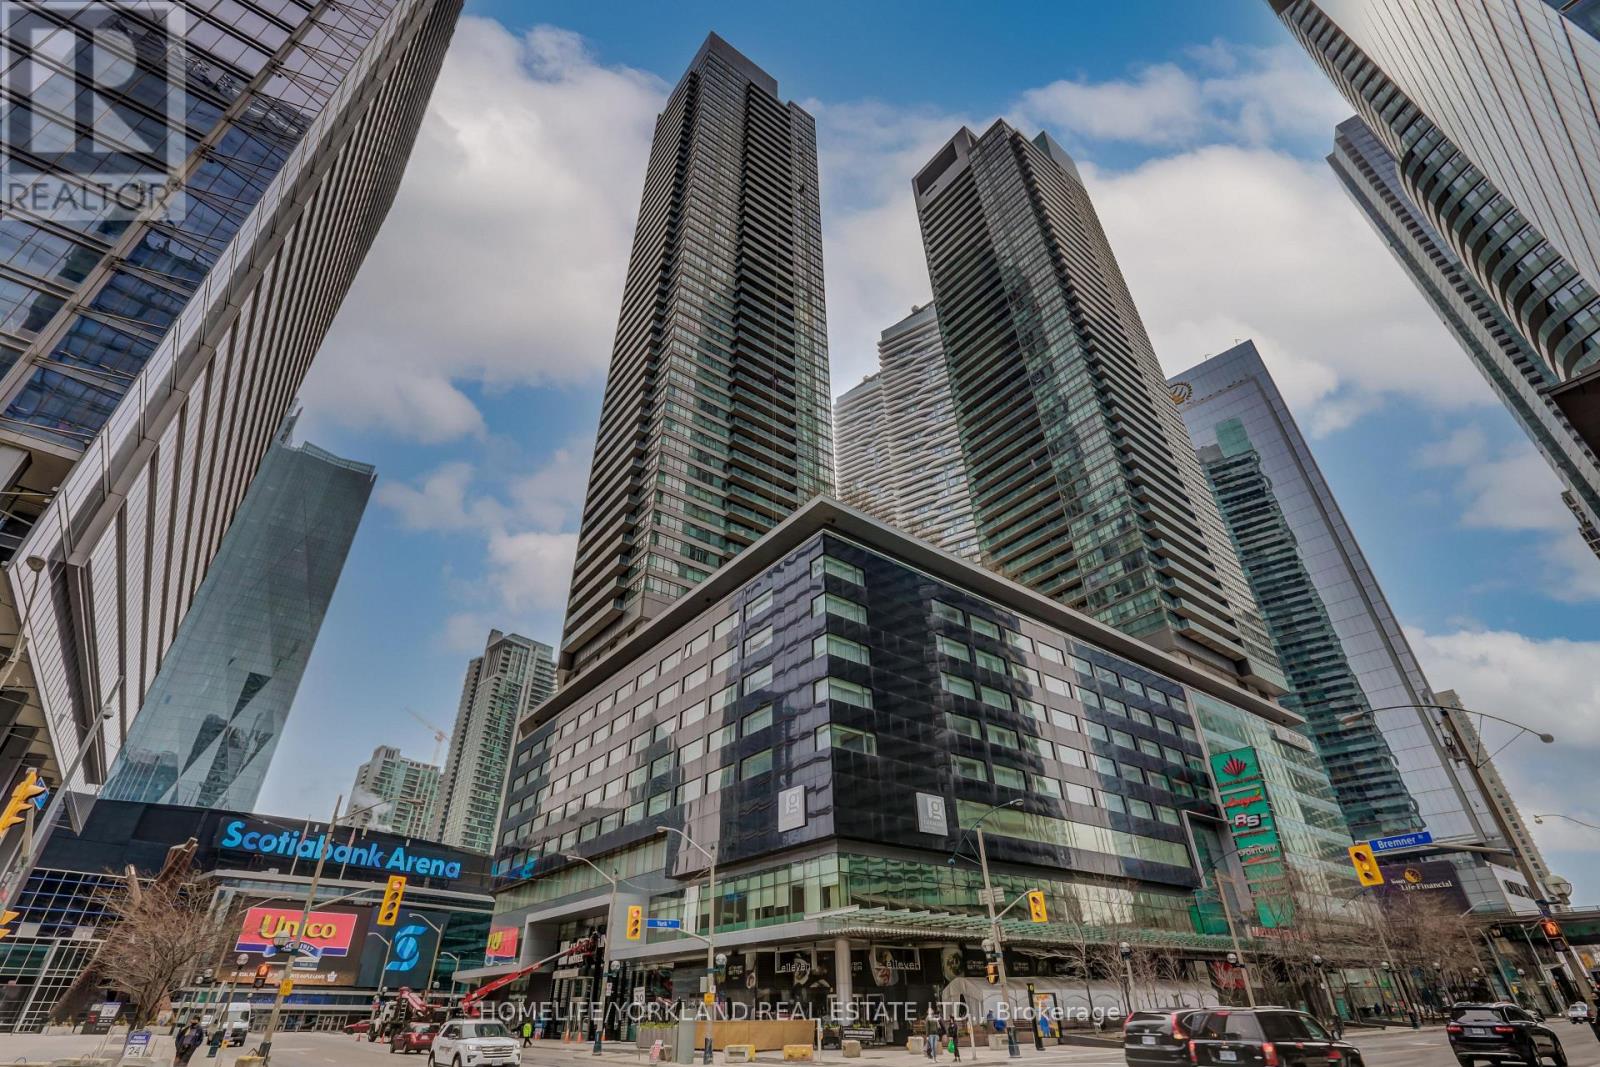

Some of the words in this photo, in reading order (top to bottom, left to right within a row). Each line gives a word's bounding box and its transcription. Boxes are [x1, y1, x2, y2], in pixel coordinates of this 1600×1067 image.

[222, 820, 386, 868] Scotiabank
[385, 847, 461, 879] Arena
[1377, 837, 1416, 849] Bremner
[1416, 880, 1453, 890] Financial
[260, 913, 337, 939] Unico
